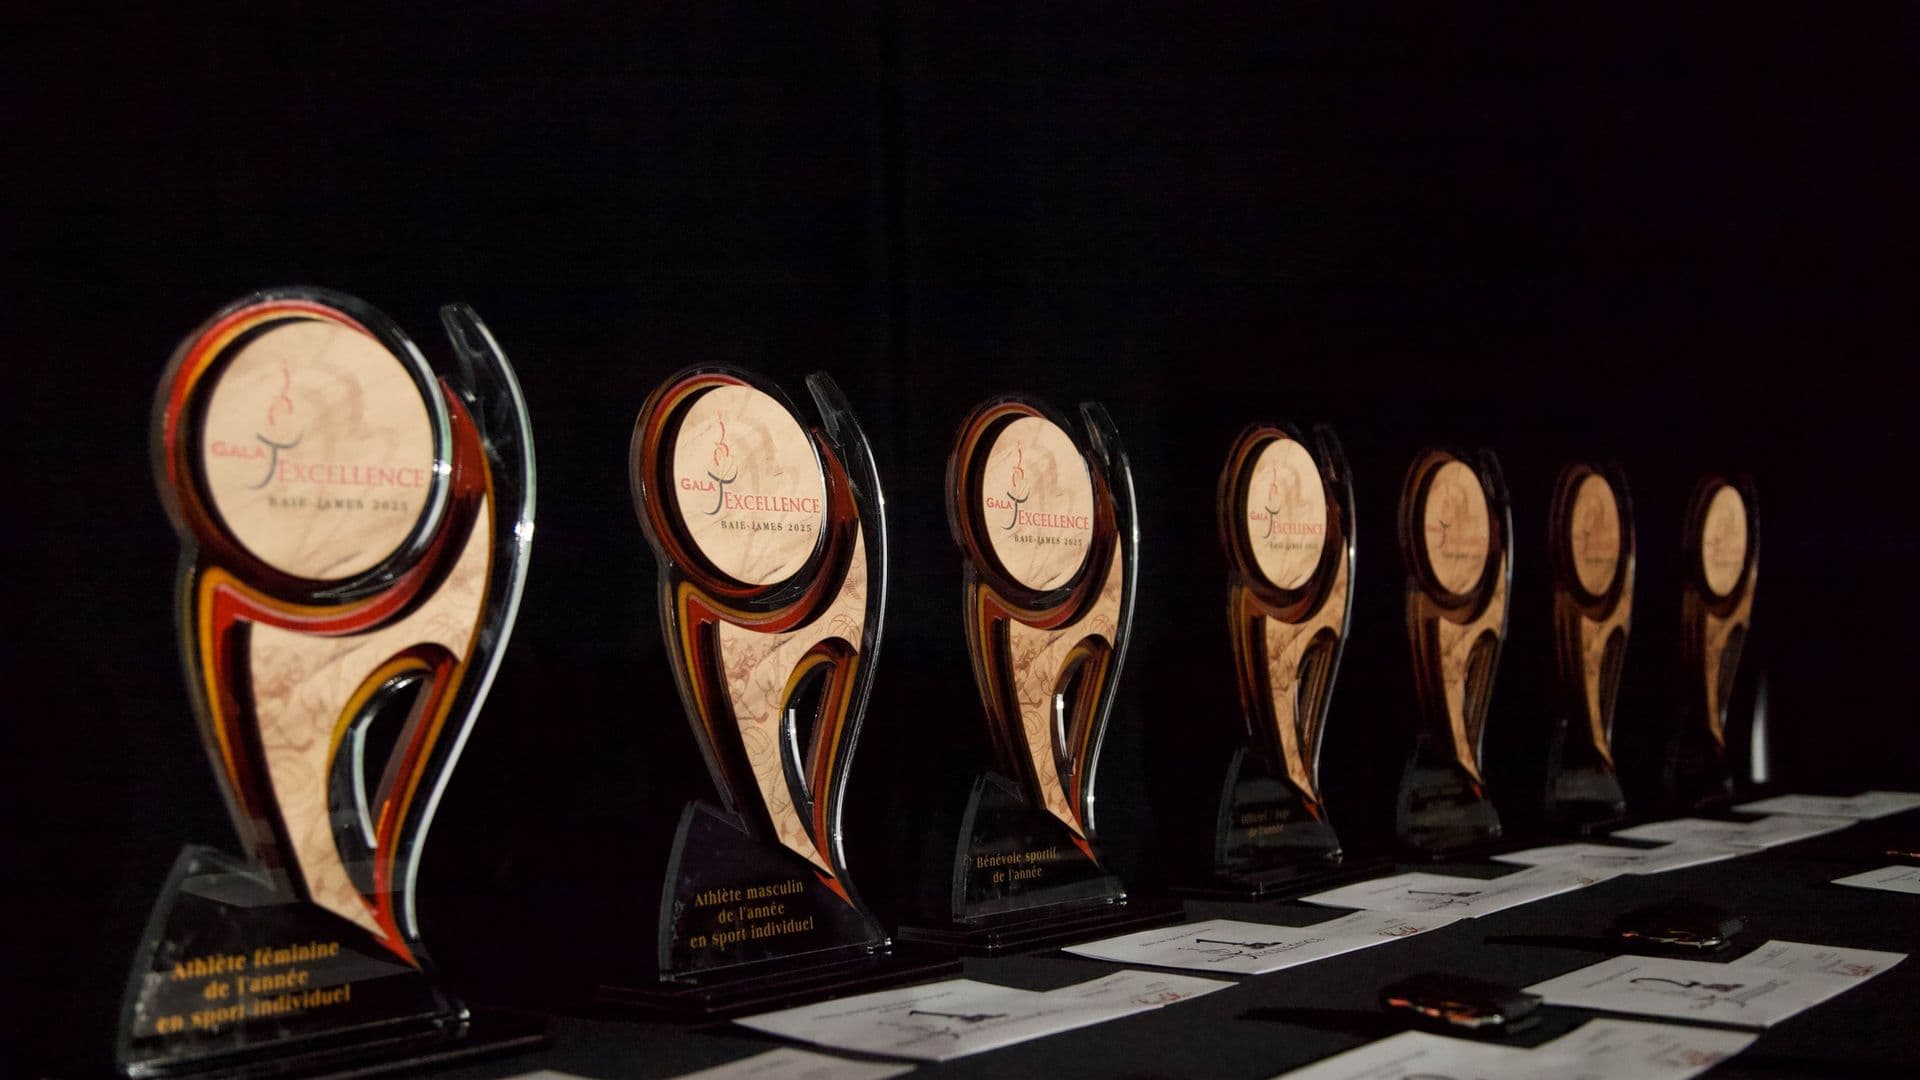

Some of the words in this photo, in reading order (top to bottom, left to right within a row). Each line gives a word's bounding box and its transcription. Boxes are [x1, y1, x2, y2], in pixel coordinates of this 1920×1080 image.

[211, 440, 265, 459] GALA
[277, 459, 425, 489] EXCELLENCE
[680, 478, 716, 492] GALA
[724, 492, 820, 514] EXCELLENCE
[720, 520, 783, 532] BAIE-JAMES
[788, 523, 812, 533] 2025
[986, 497, 1013, 509] GALA
[1018, 510, 1089, 530] EXCELLENCE
[977, 852, 1021, 869] Bénévole
[1025, 846, 1057, 864] sportif
[993, 871, 1004, 883] de
[1008, 865, 1042, 881] l'année
[694, 886, 742, 907] Athlète
[747, 880, 804, 900] masculin
[718, 909, 734, 924] de
[739, 902, 785, 920] l'année
[689, 934, 707, 949] en
[712, 929, 746, 951] sport
[751, 916, 814, 939] individuel
[171, 952, 247, 982] Athlète
[254, 941, 340, 966] féminine
[204, 980, 229, 999] de
[238, 969, 309, 995] l'année
[155, 1014, 184, 1034] en
[191, 1003, 247, 1029] sport
[253, 984, 351, 1016] individuel
